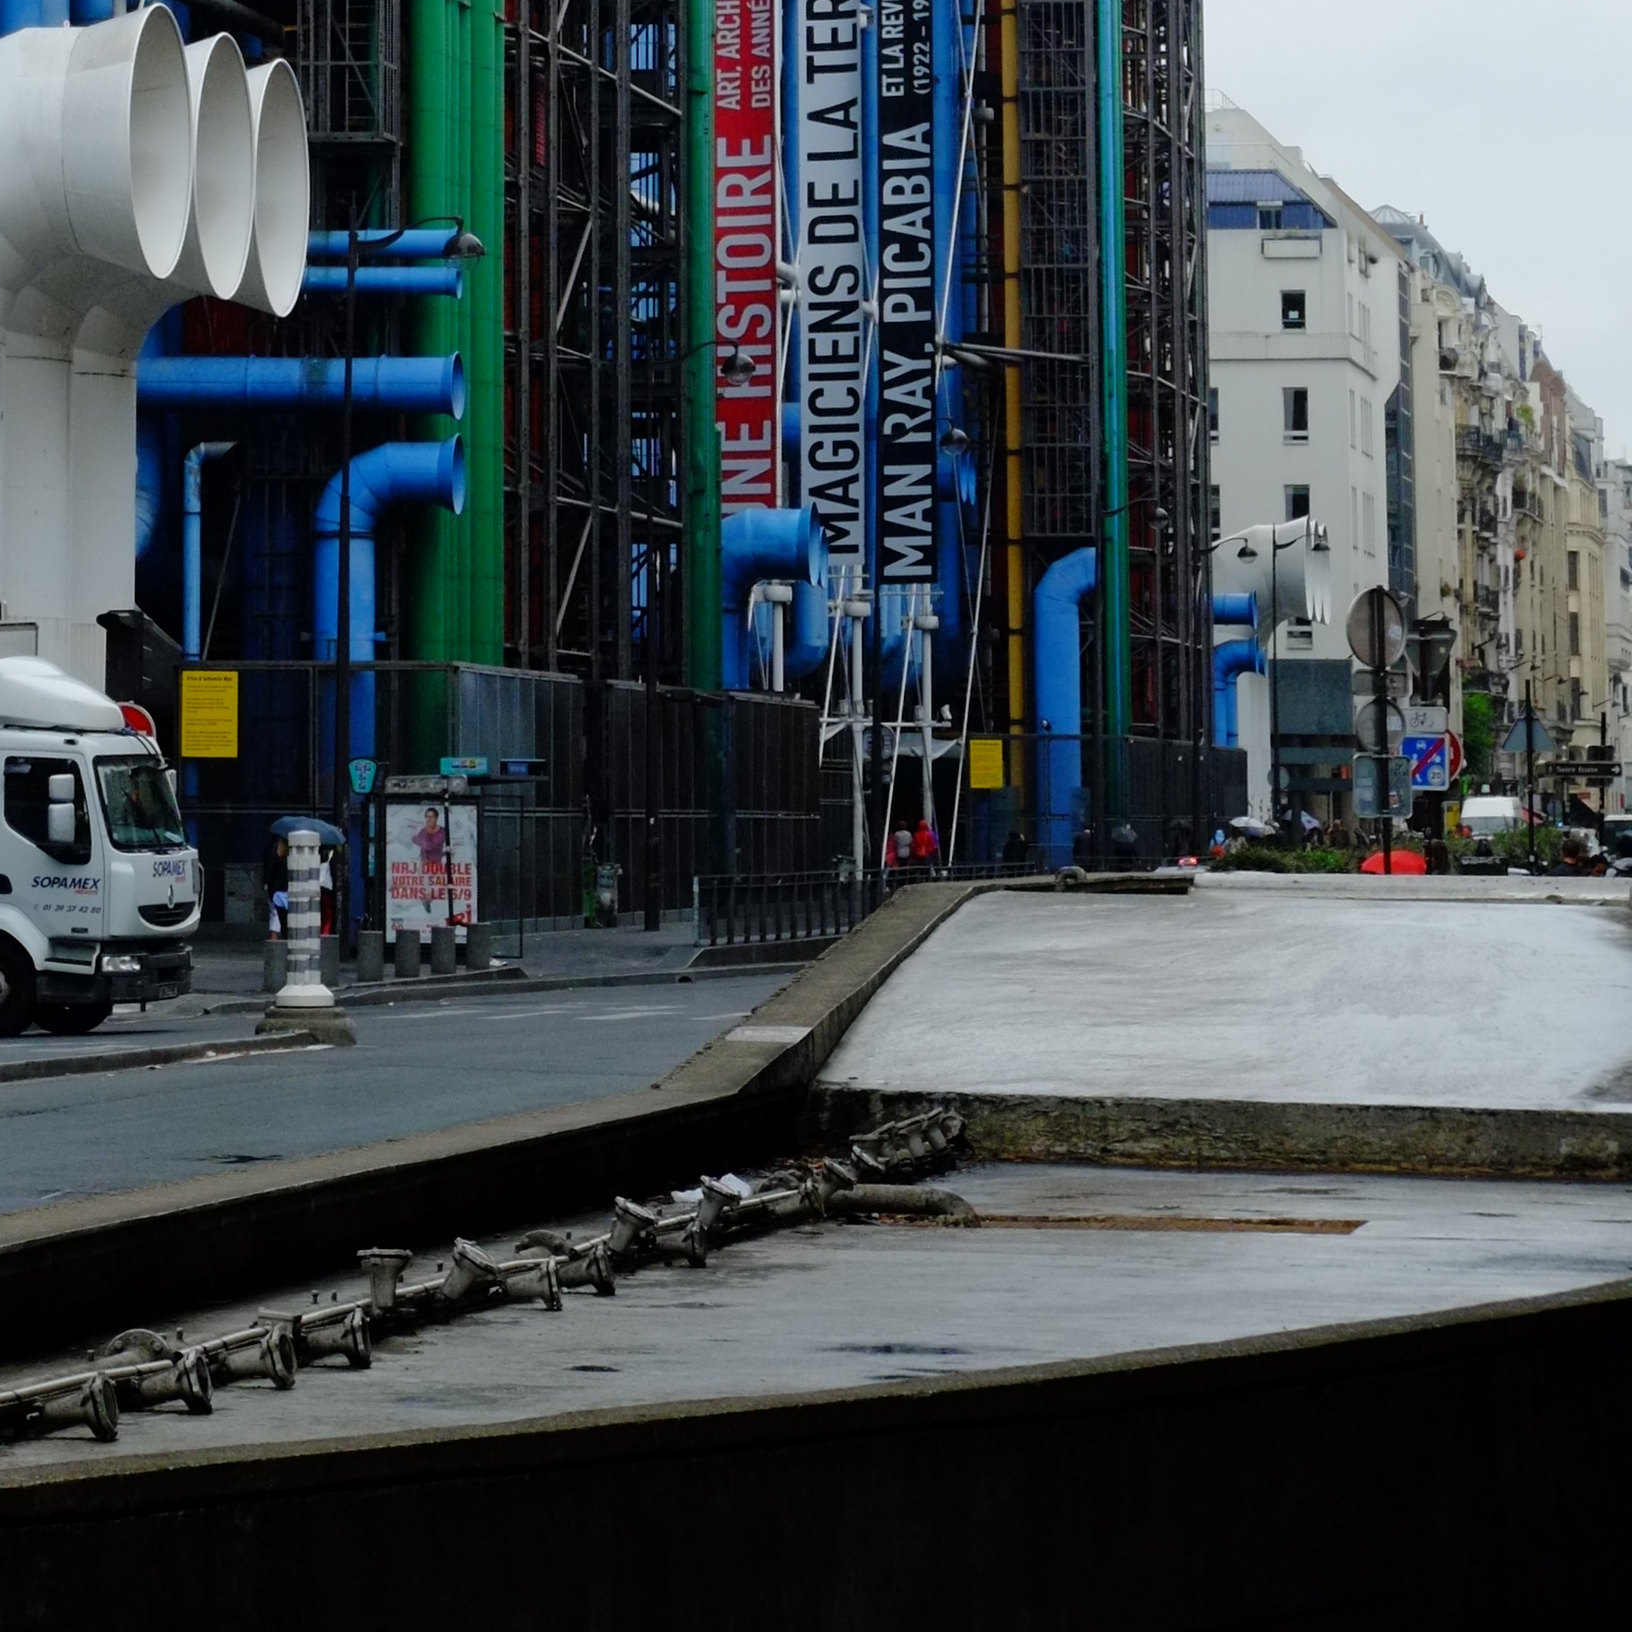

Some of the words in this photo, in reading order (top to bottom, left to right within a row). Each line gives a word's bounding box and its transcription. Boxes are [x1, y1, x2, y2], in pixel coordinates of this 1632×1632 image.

[880, 43, 905, 69] LA
[912, 41, 931, 95] (1922
[716, 66, 742, 111] ART,
[751, 64, 772, 108] DES
[880, 74, 905, 97] ET
[806, 96, 859, 161] LA
[807, 178, 860, 244] DE
[881, 121, 932, 322] PICABIA
[716, 134, 772, 398] HISTOIRE
[807, 263, 860, 555] MAGICIENS
[882, 342, 933, 443] RAY,
[882, 463, 933, 577] MAN
[1431, 770, 1442, 779] 20
[31, 876, 101, 890] SOPAMEX
[391, 862, 418, 875] NRJ
[422, 862, 472, 875] DOUBLE
[392, 876, 425, 886] VOTRE
[428, 876, 472, 886] SALAIRE
[391, 887, 426, 900] DANS
[430, 888, 446, 900] LE
